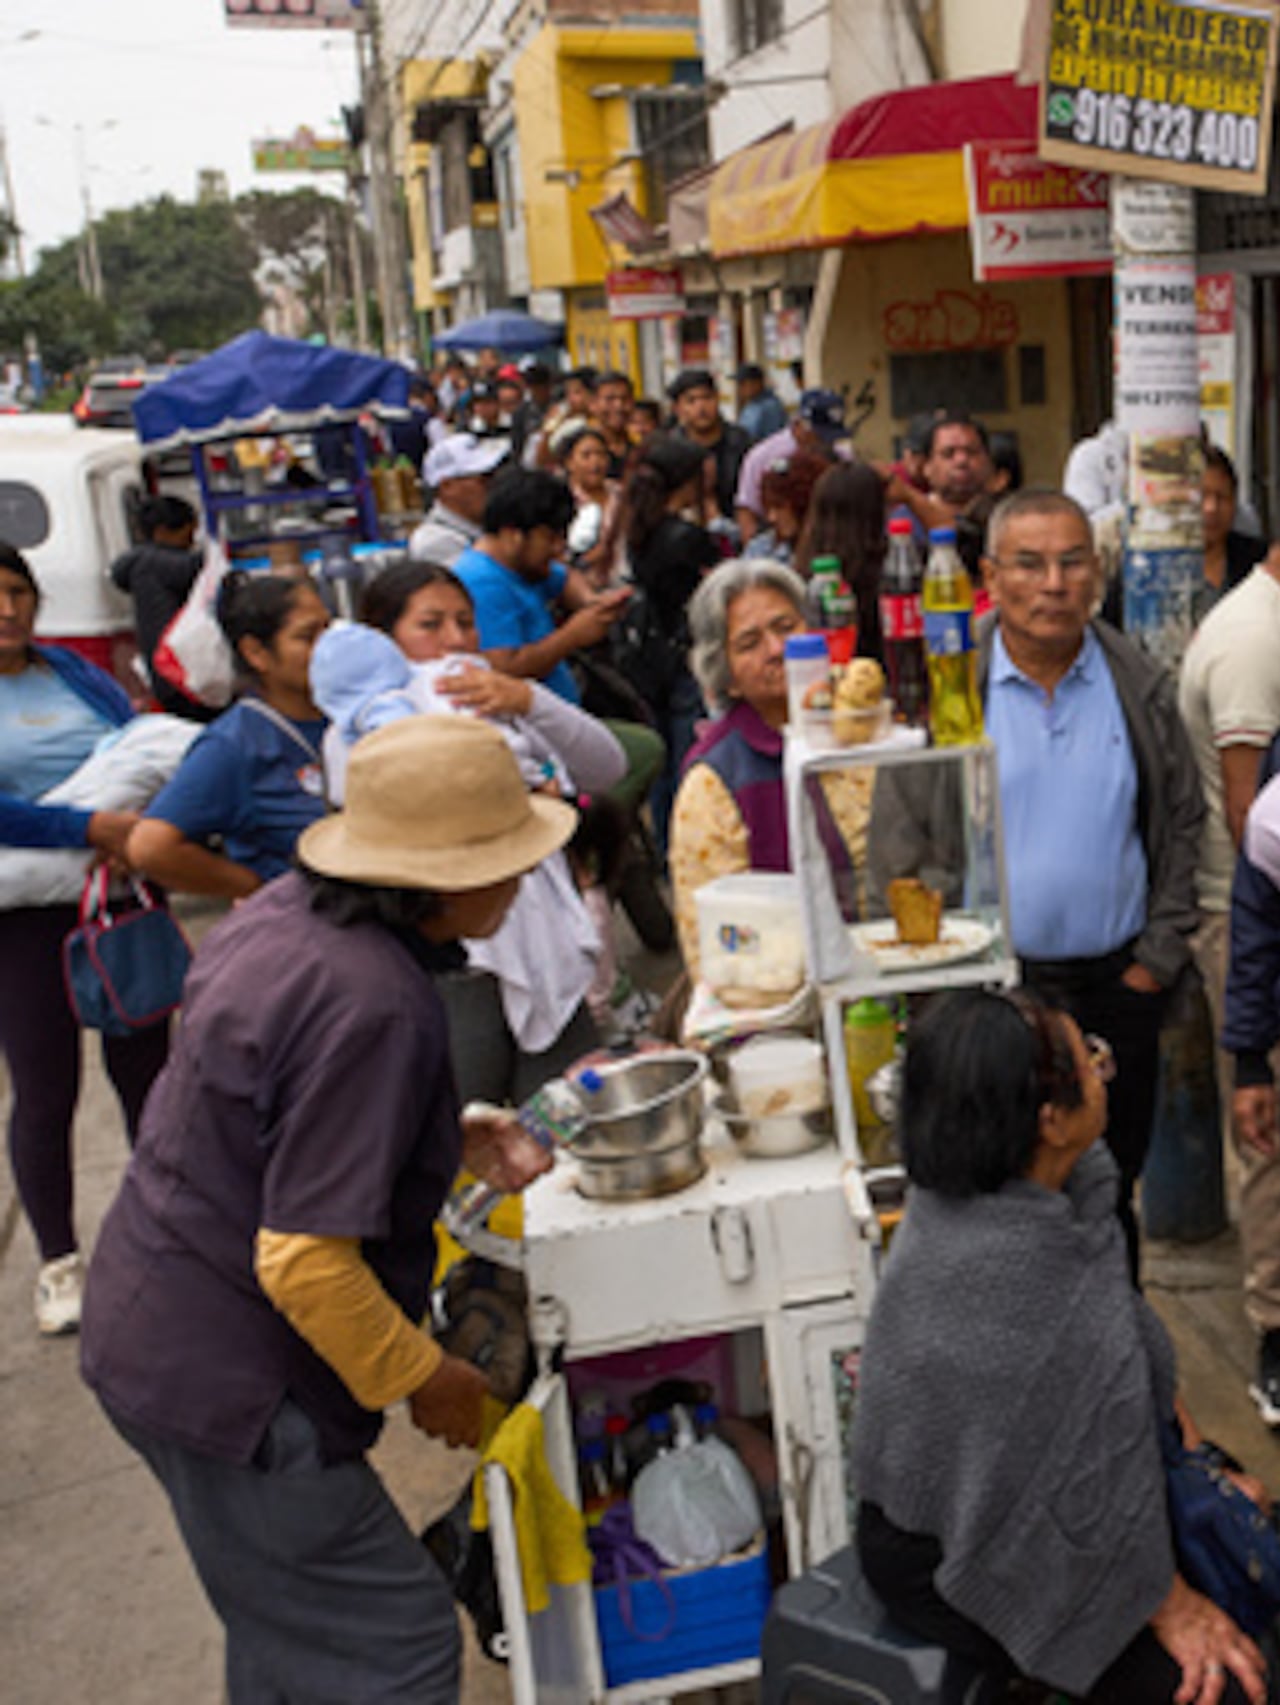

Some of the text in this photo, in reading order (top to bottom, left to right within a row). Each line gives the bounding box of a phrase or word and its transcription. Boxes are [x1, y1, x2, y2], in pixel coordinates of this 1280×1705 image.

[1053, 0, 1267, 52] CURANDERO
[1049, 53, 1138, 98] EXPERTO
[1074, 87, 1258, 170] 916 323 400
